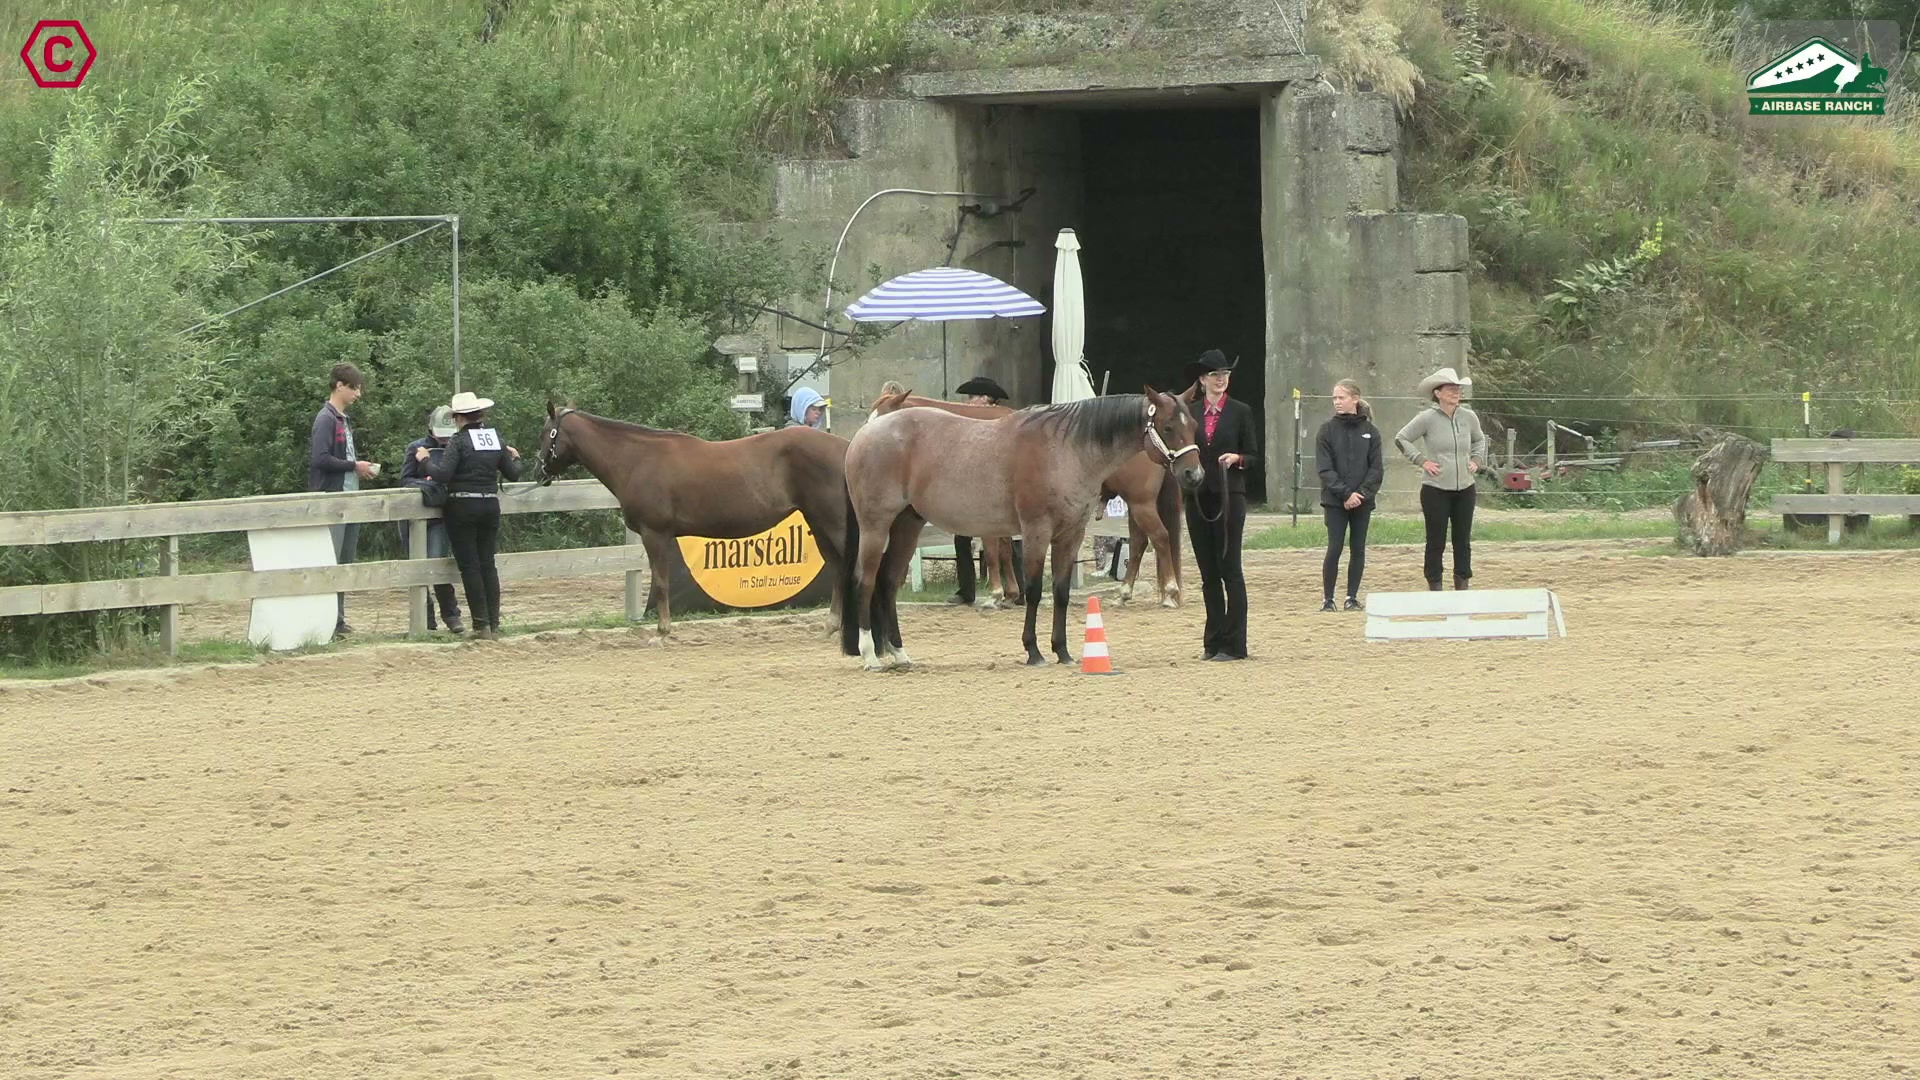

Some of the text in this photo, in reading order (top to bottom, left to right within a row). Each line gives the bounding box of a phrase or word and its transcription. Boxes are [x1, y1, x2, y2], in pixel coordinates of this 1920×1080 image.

[477, 433, 494, 447] 56
[703, 524, 803, 569] marstall
[739, 574, 801, 589] Im Stall zu Hause
